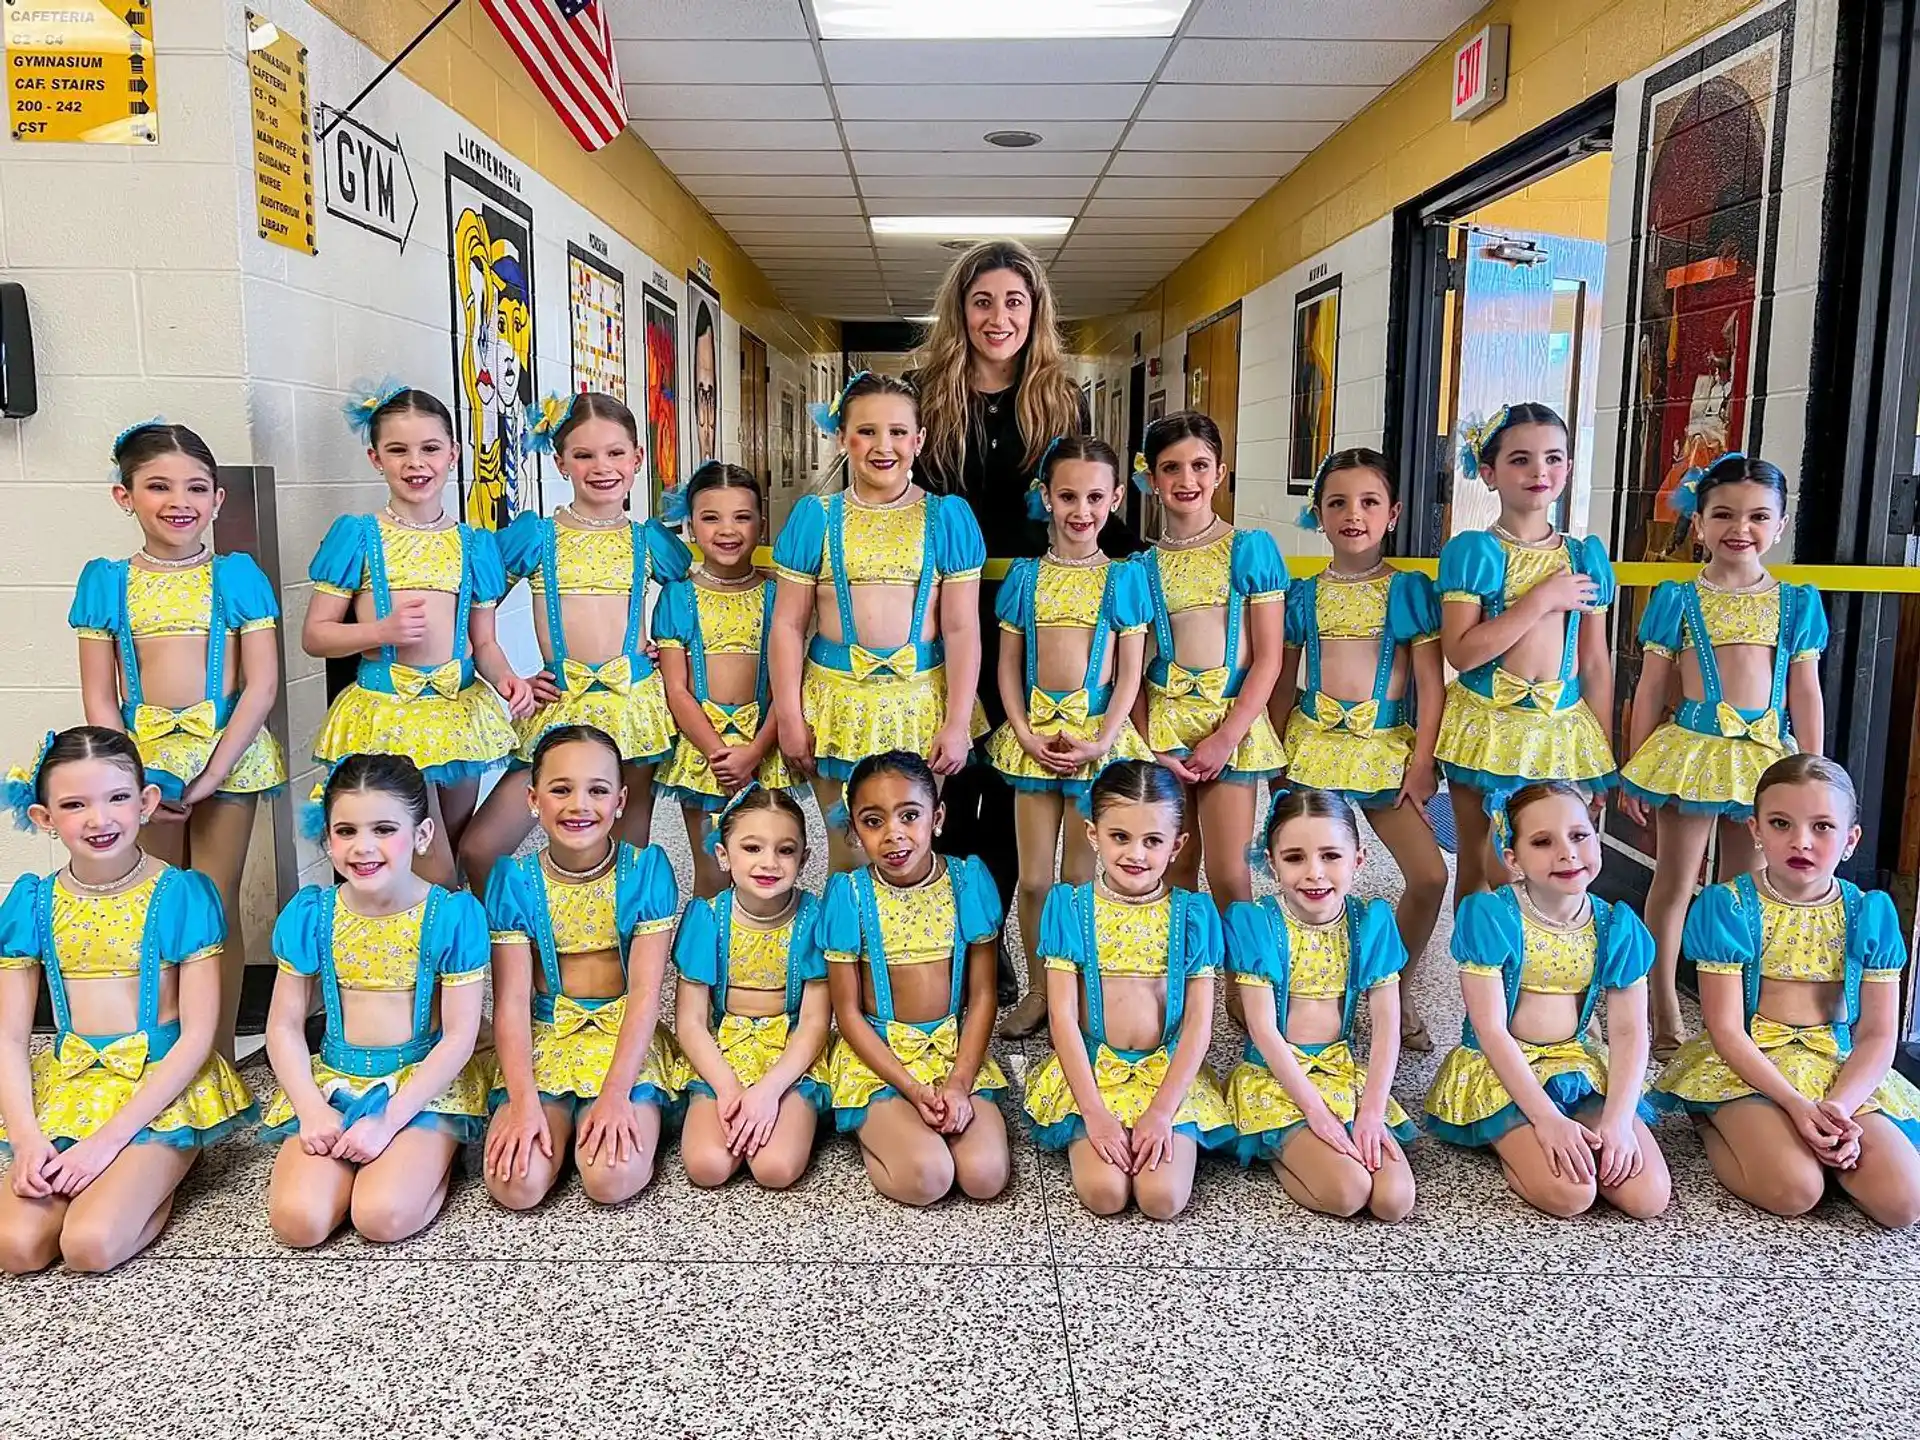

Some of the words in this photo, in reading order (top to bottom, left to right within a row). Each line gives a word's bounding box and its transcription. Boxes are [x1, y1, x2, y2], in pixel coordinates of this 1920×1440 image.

[11, 11, 95, 22] CAFETERIA
[13, 56, 103, 68] GYMNASIUM
[1456, 37, 1483, 107] EXIT
[15, 78, 46, 90] CAF.
[51, 79, 105, 91] STAIRS
[252, 65, 287, 92] CAFETERIA
[16, 100, 43, 112] 200
[56, 101, 82, 112] 242
[17, 121, 48, 133] CST
[257, 129, 274, 148] MAIN
[275, 138, 297, 158] OFFICE
[258, 151, 291, 175] GUIDANCE
[458, 131, 521, 193] LICHTENSTEIN
[258, 172, 281, 191] NURSE
[337, 129, 395, 223] GYM
[260, 194, 300, 219] AUDITORIUM
[261, 216, 289, 236] LIBRARY
